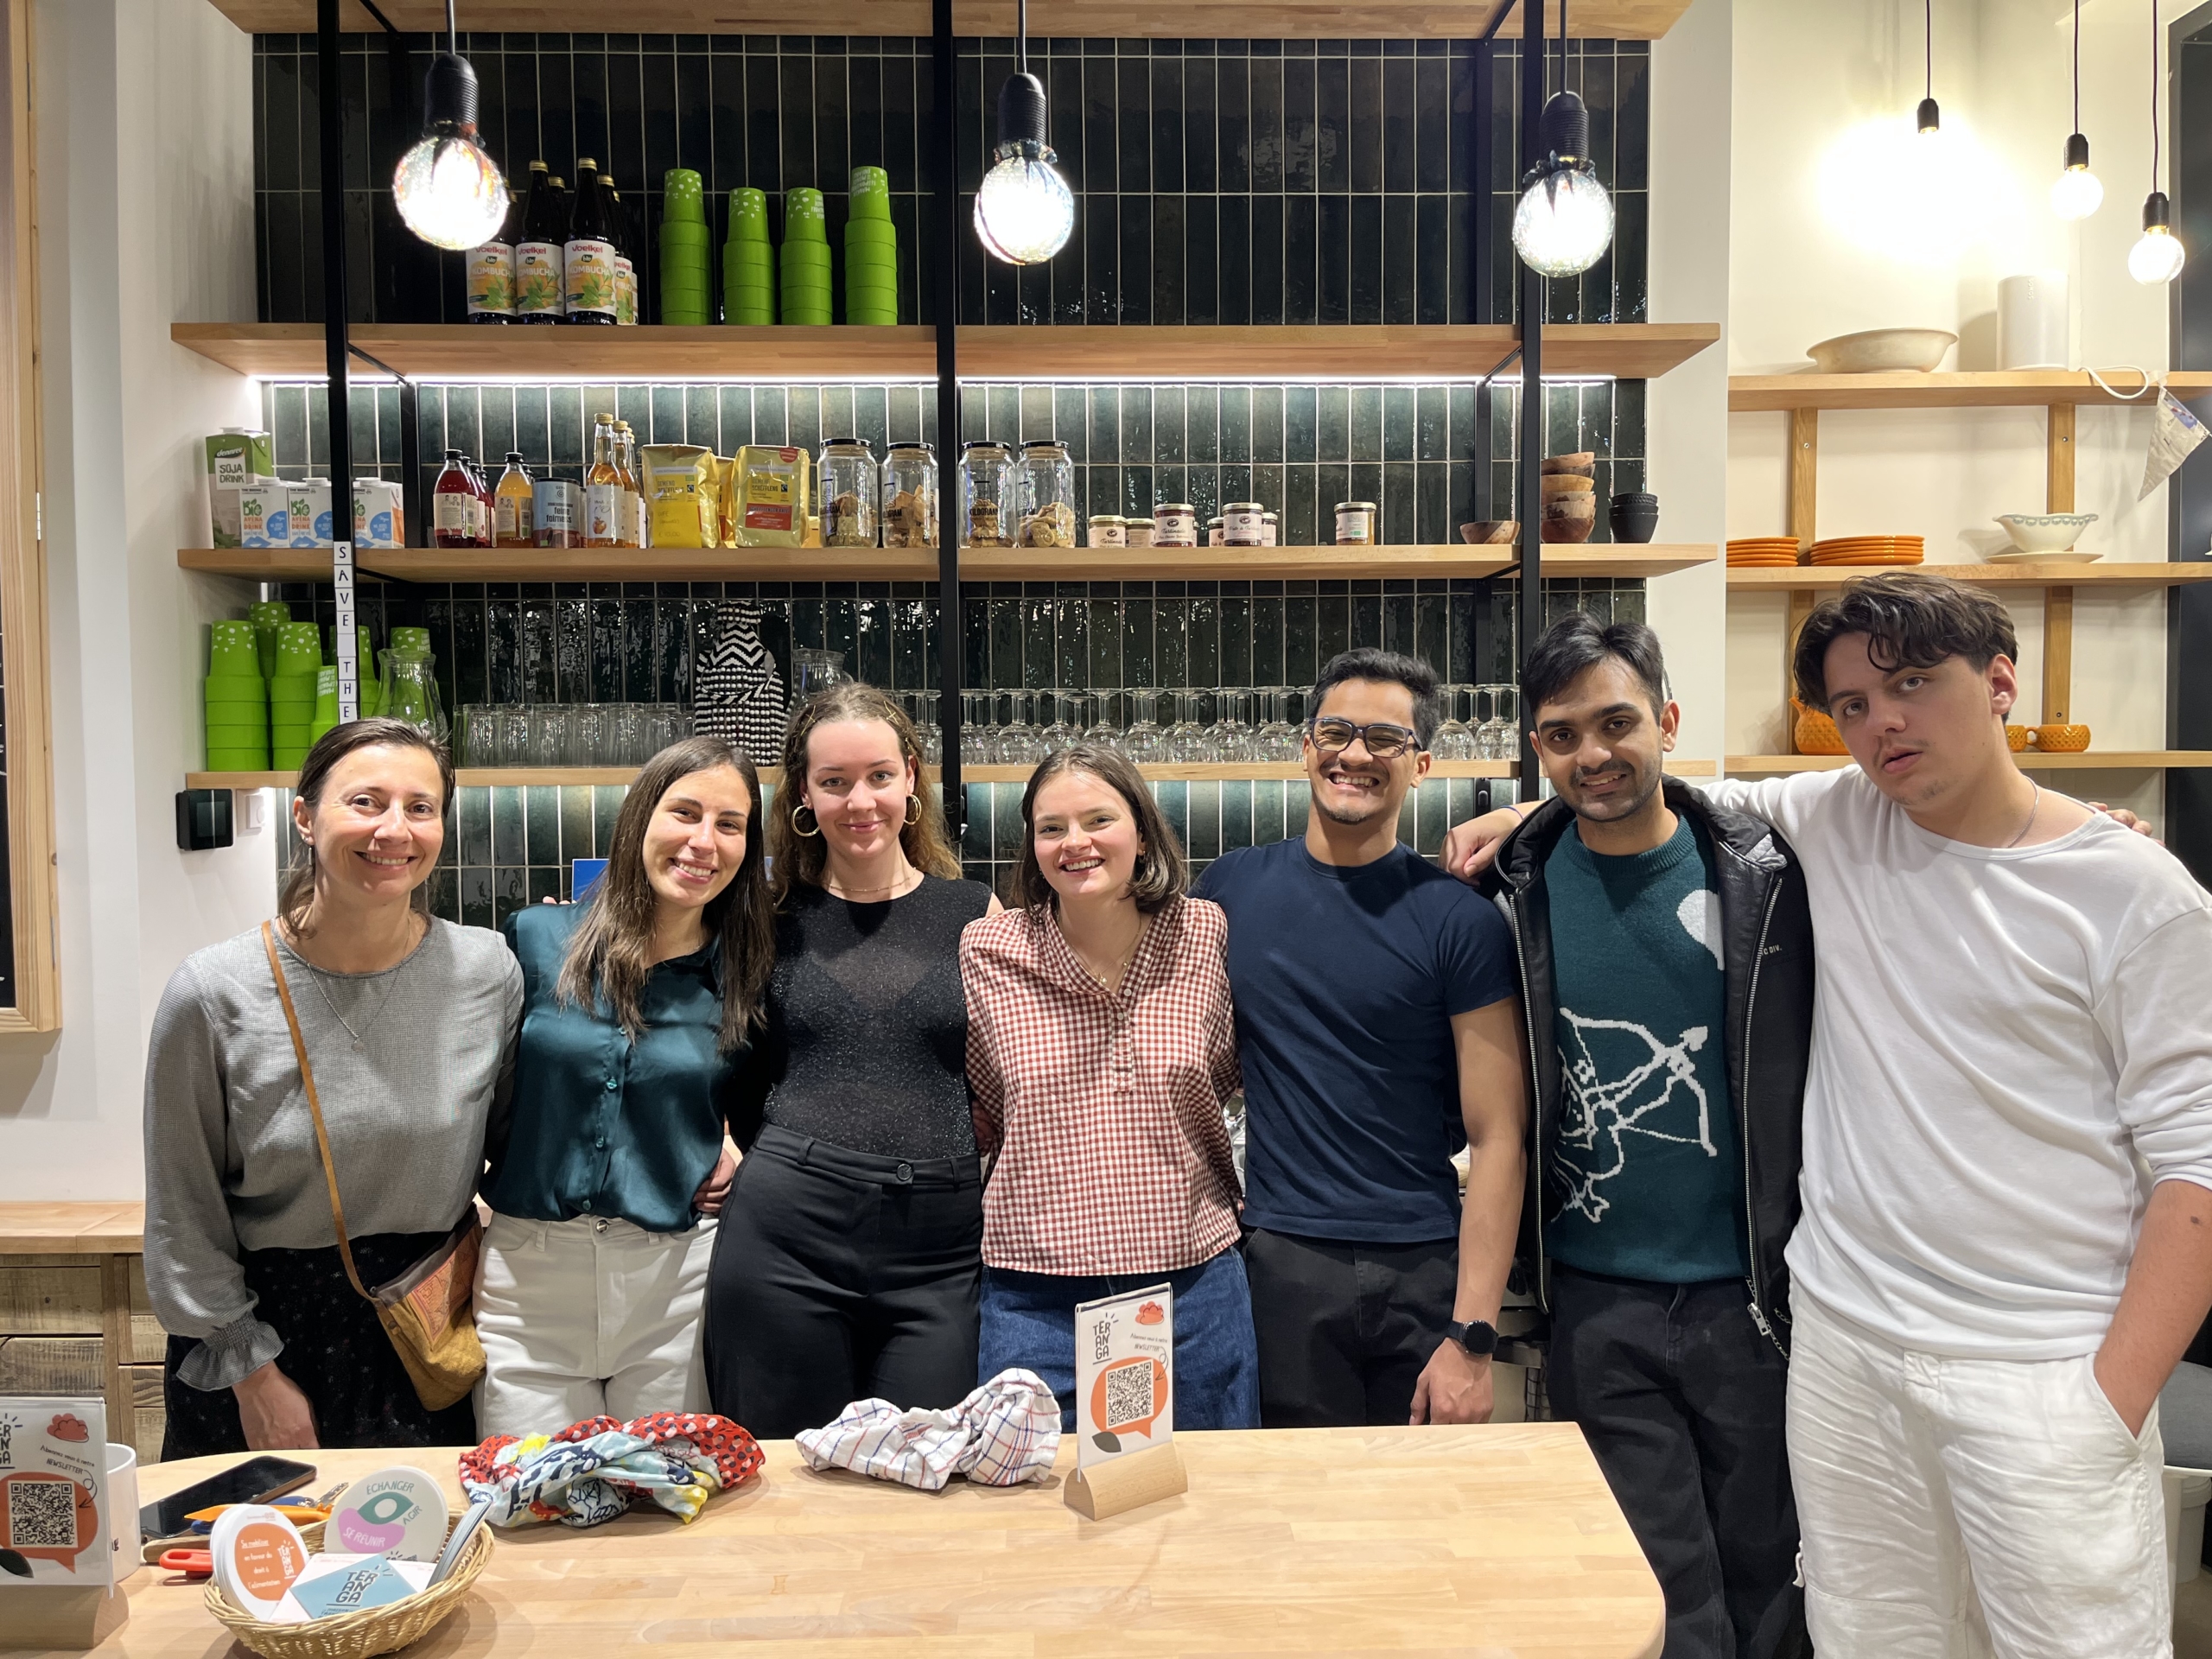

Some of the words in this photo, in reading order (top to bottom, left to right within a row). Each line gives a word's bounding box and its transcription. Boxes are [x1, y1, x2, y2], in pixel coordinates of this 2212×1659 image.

[518, 267, 556, 277] OMBUCHA
[217, 448, 243, 457] dennree
[219, 464, 243, 474] SOJA
[219, 474, 245, 483] DRINK
[339, 547, 349, 626] SAVE
[1769, 944, 1783, 954] DIV.
[1093, 1320, 1111, 1336] TER
[1096, 1333, 1110, 1348] AN
[1096, 1345, 1109, 1360] GA
[40, 1445, 63, 1458] Abonnez
[80, 1459, 95, 1467] notre
[47, 1458, 84, 1474] NEWSLETTER
[366, 1480, 415, 1495] ÉCHANGER
[403, 1505, 423, 1525] AGIR
[343, 1527, 355, 1539] SE
[353, 1531, 386, 1548] RÉUNIR
[277, 1545, 290, 1557] TER
[283, 1565, 295, 1576] GA
[347, 1570, 378, 1583] TER
[341, 1581, 372, 1592] AN
[335, 1591, 362, 1603] GA
